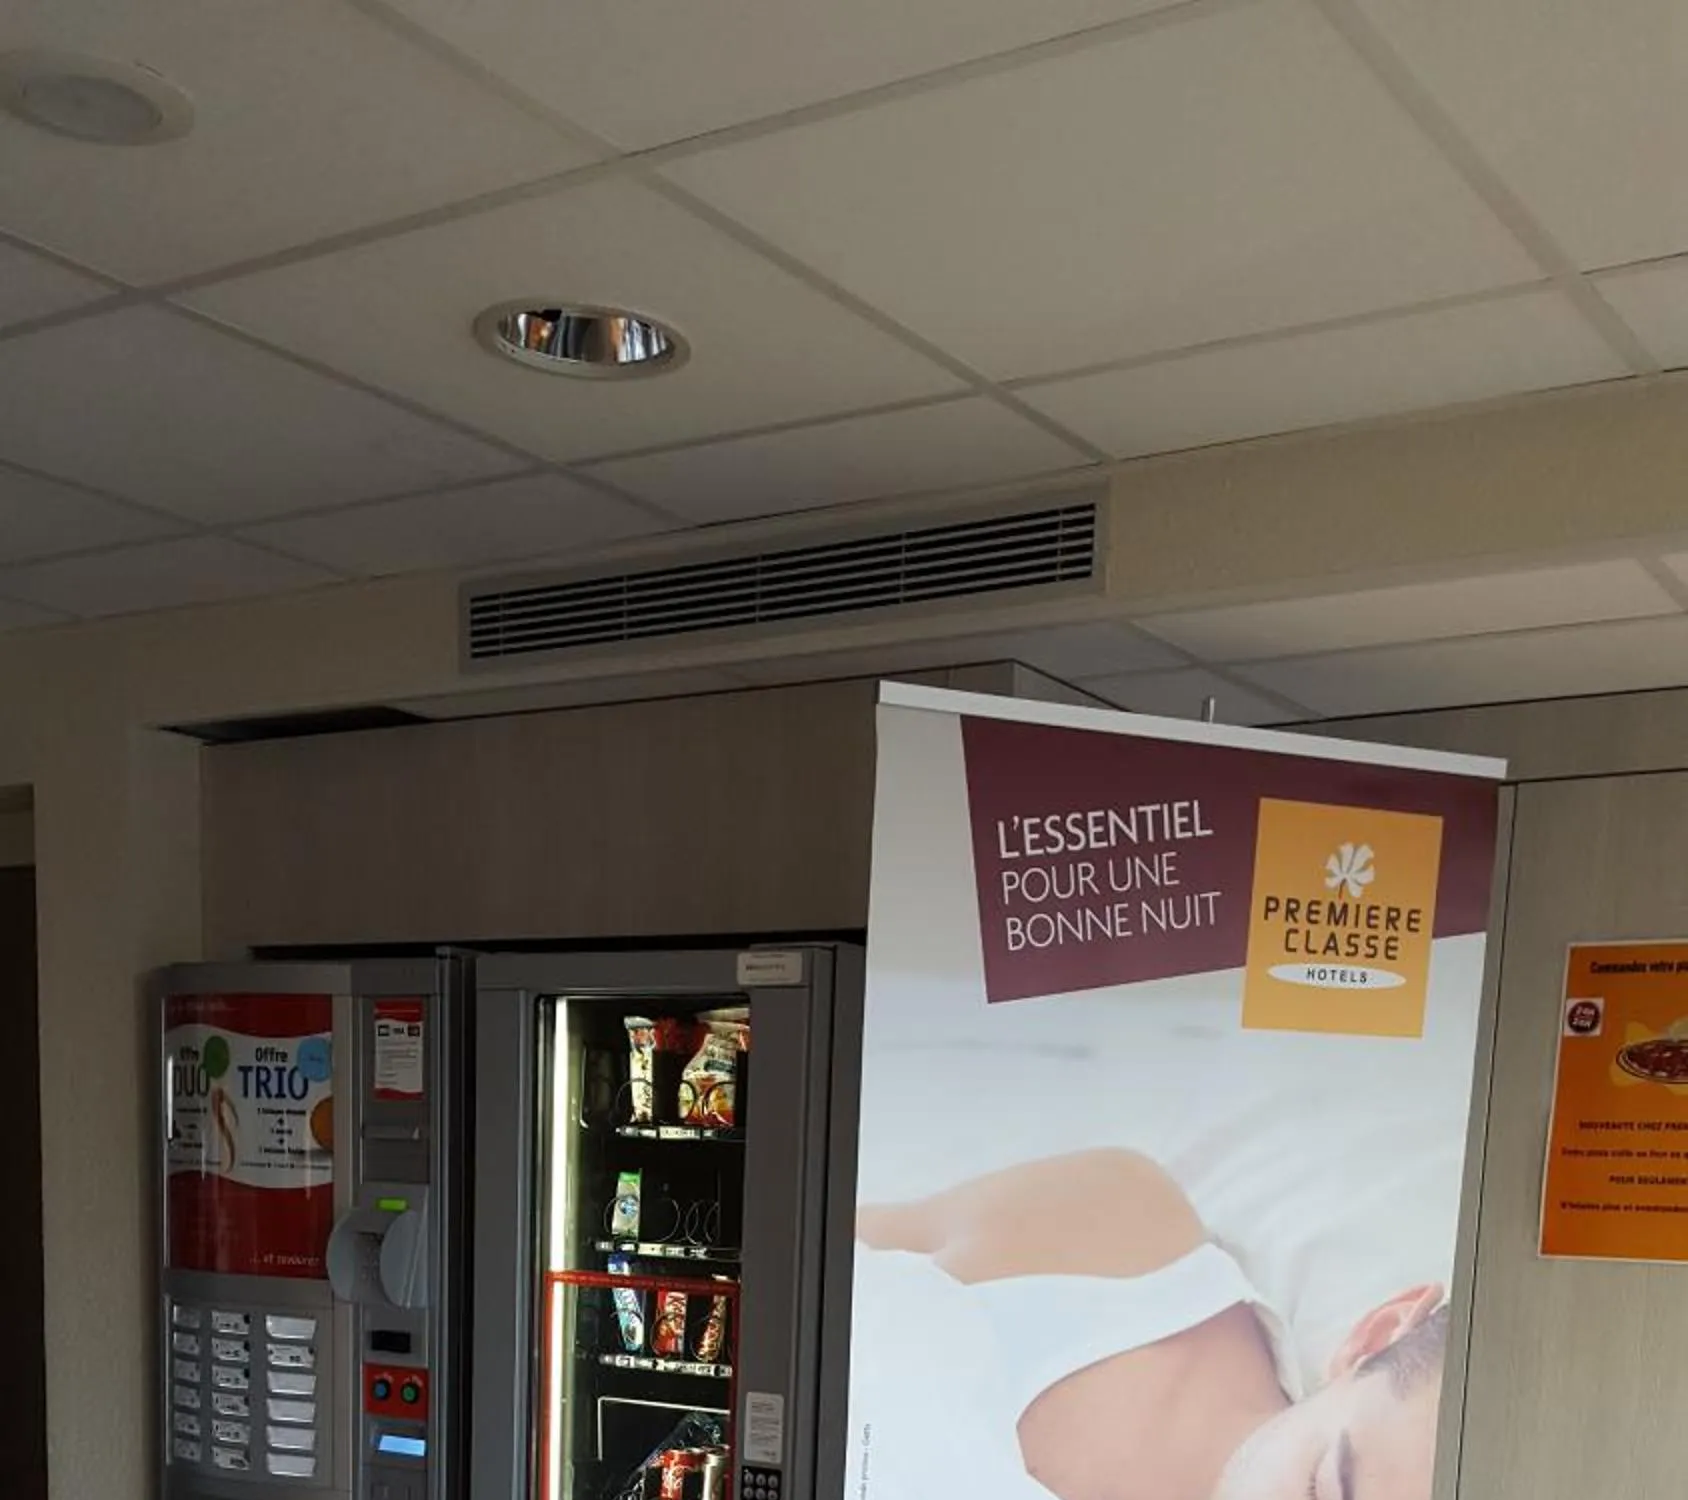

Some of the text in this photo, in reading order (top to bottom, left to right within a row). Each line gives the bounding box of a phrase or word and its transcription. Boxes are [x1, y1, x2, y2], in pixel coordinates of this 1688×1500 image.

[997, 799, 1213, 859] L'ESSENTIEL
[1002, 851, 1179, 904] POUR UNE
[1006, 891, 1221, 951] BONNE NUIT
[1263, 896, 1422, 933] PREMIERE
[1284, 930, 1400, 961] CLASSE
[1306, 967, 1368, 984] HOTELS
[255, 1046, 289, 1063] Offre
[237, 1065, 309, 1101] TRIO
